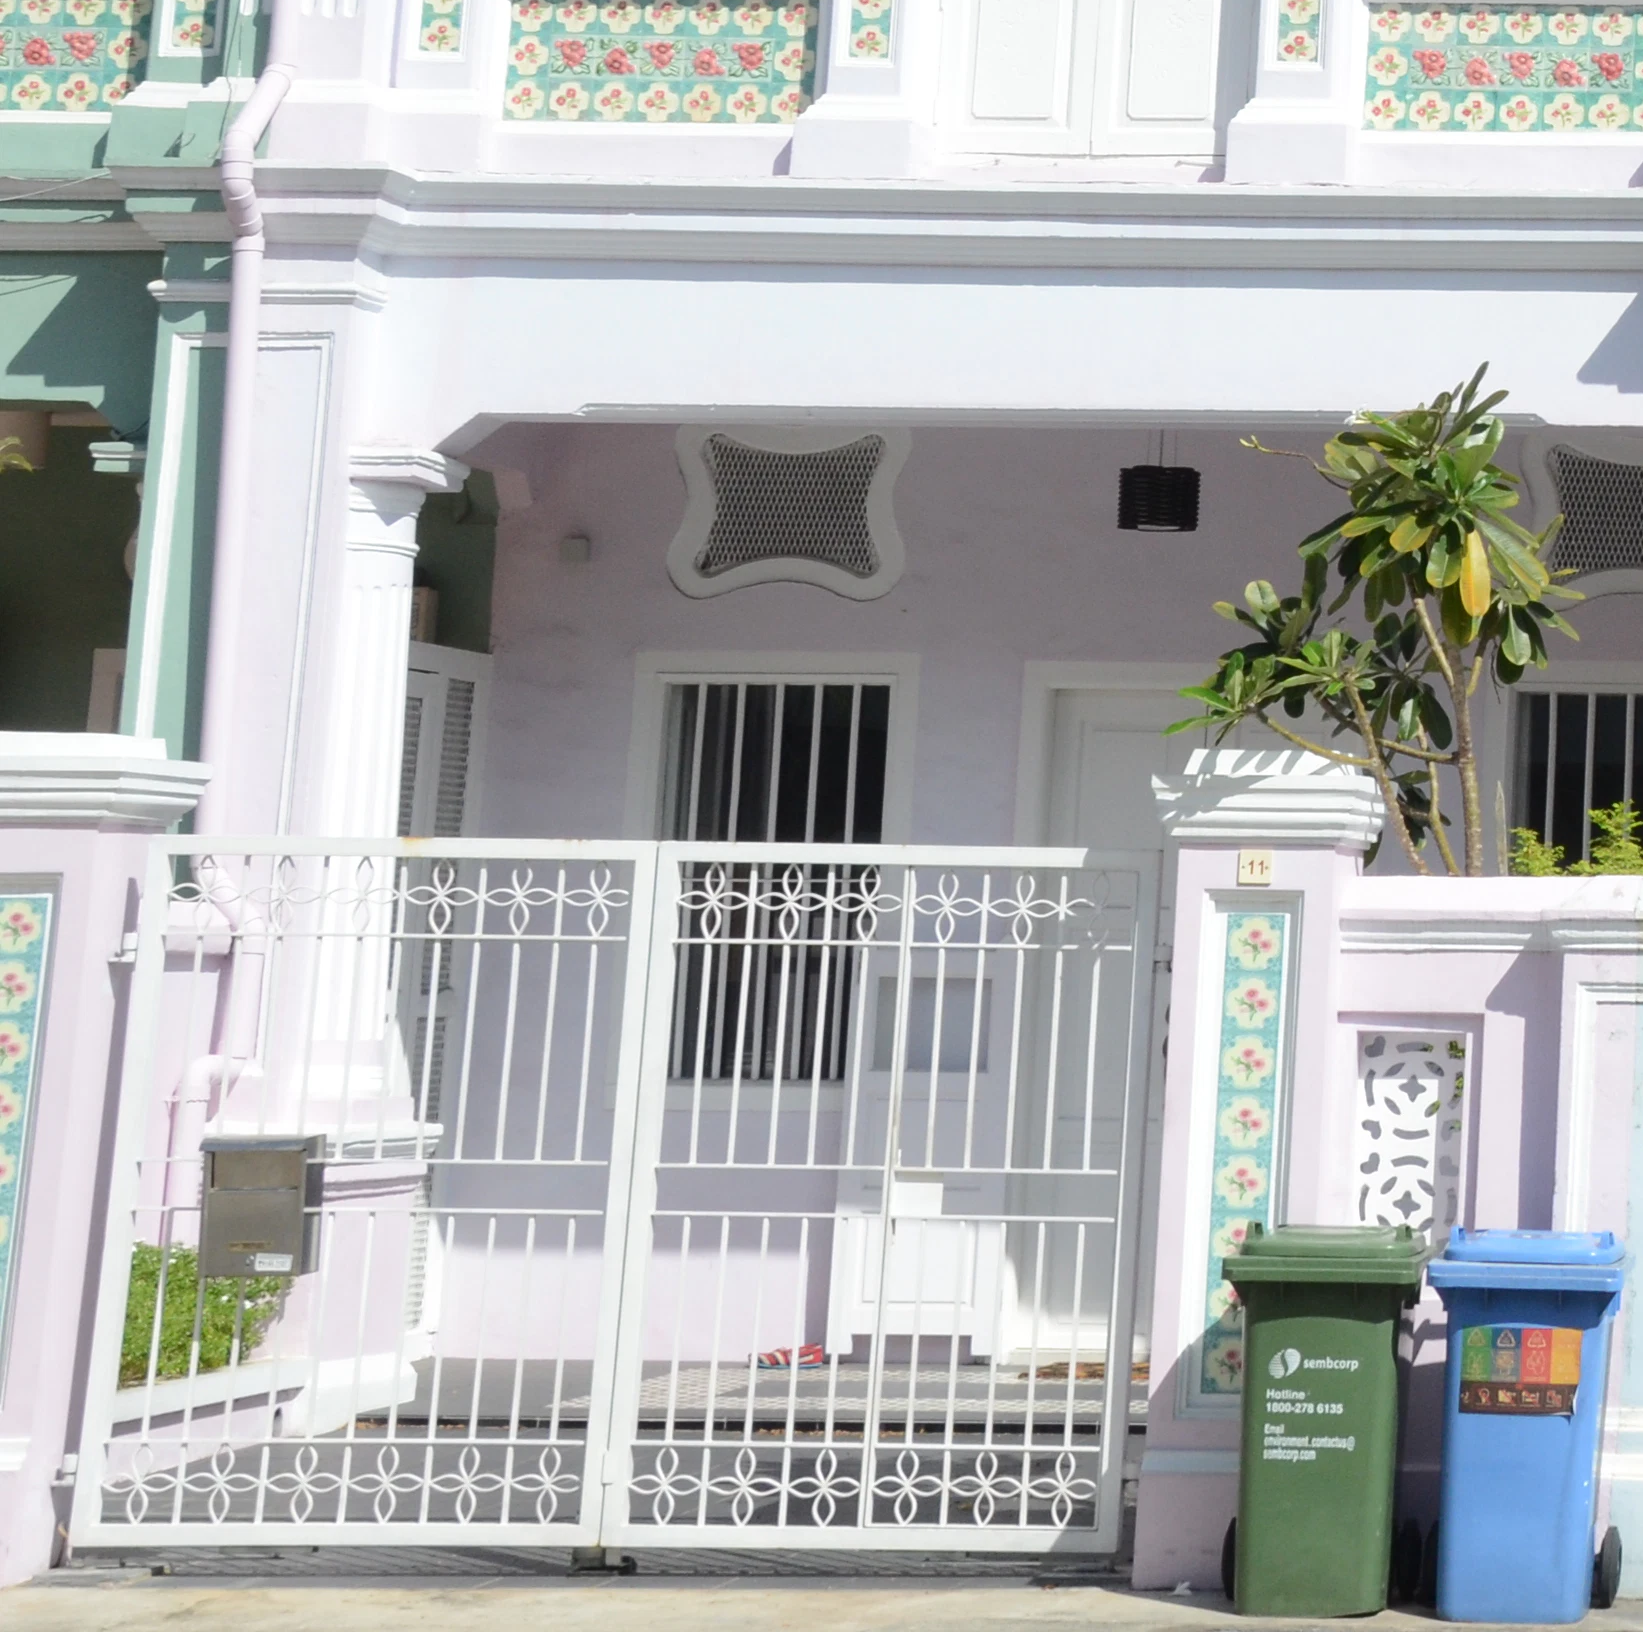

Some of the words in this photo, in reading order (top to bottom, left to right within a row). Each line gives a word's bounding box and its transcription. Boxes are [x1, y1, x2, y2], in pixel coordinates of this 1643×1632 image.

[1248, 859, 1264, 875] 11
[1303, 1357, 1359, 1372] sembcorp
[1266, 1388, 1306, 1400] Hotline
[1266, 1402, 1314, 1414] 1800-278
[1317, 1403, 1343, 1415] 6135
[1264, 1423, 1285, 1434] Email
[1263, 1448, 1316, 1462] sembcorp.com
